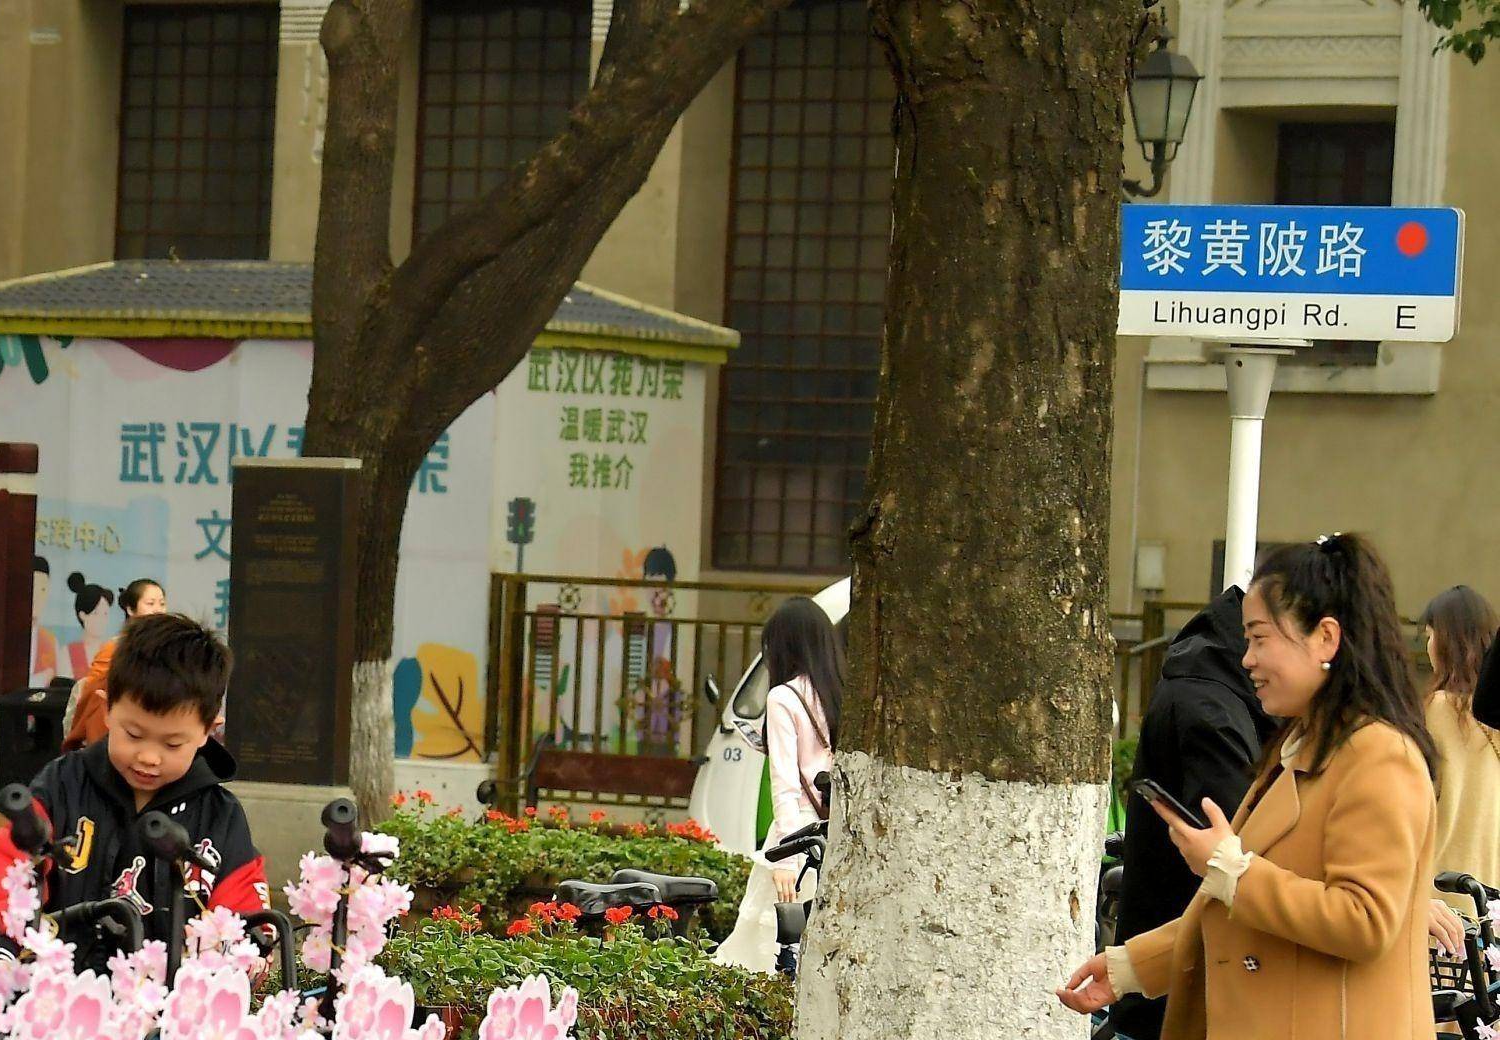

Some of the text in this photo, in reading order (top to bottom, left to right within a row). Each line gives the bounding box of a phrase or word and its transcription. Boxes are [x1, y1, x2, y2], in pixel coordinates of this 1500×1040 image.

[1142, 219, 1367, 278] 黎黄陂路
[1154, 301, 1417, 330] Lihuangpi Rd. E
[528, 350, 685, 399] 武汉以我为荣
[560, 405, 648, 444] 温暖武汉
[568, 452, 634, 490] 我推介
[723, 747, 742, 762] 03
